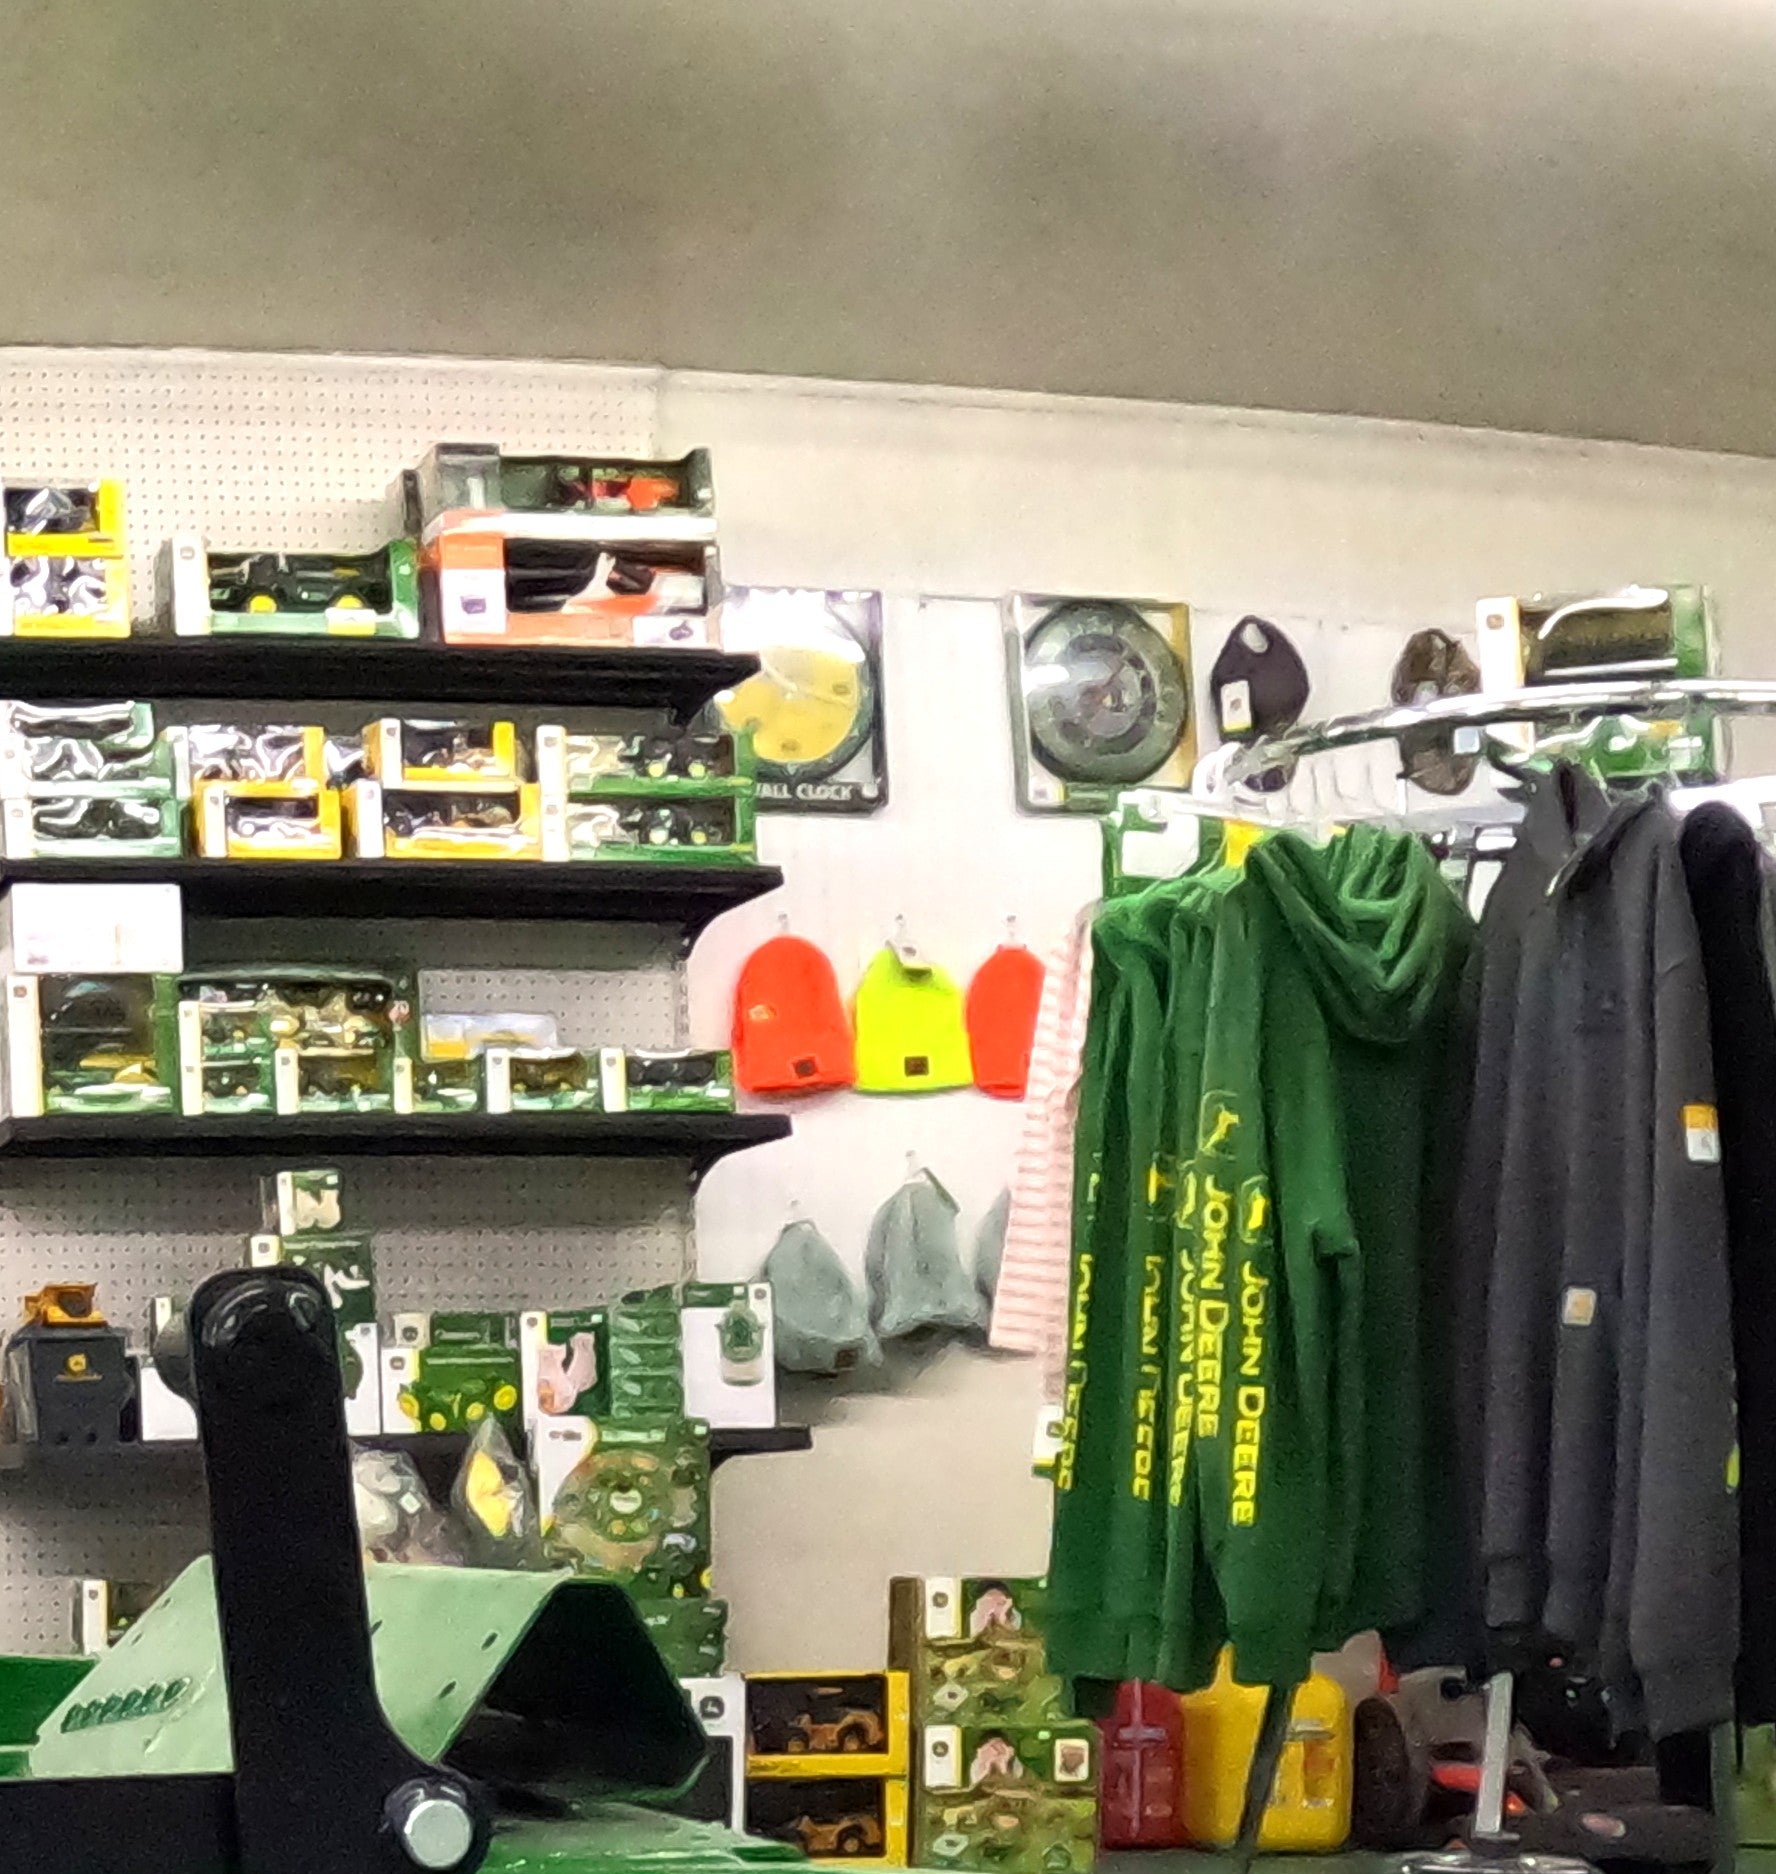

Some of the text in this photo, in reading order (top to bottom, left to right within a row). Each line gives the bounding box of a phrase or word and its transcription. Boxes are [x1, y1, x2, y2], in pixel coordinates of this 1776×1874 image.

[795, 783, 853, 801] CLOCK
[1196, 1174, 1232, 1439] JOHN DEERE
[1231, 1259, 1270, 1527] JOHN DEERE
